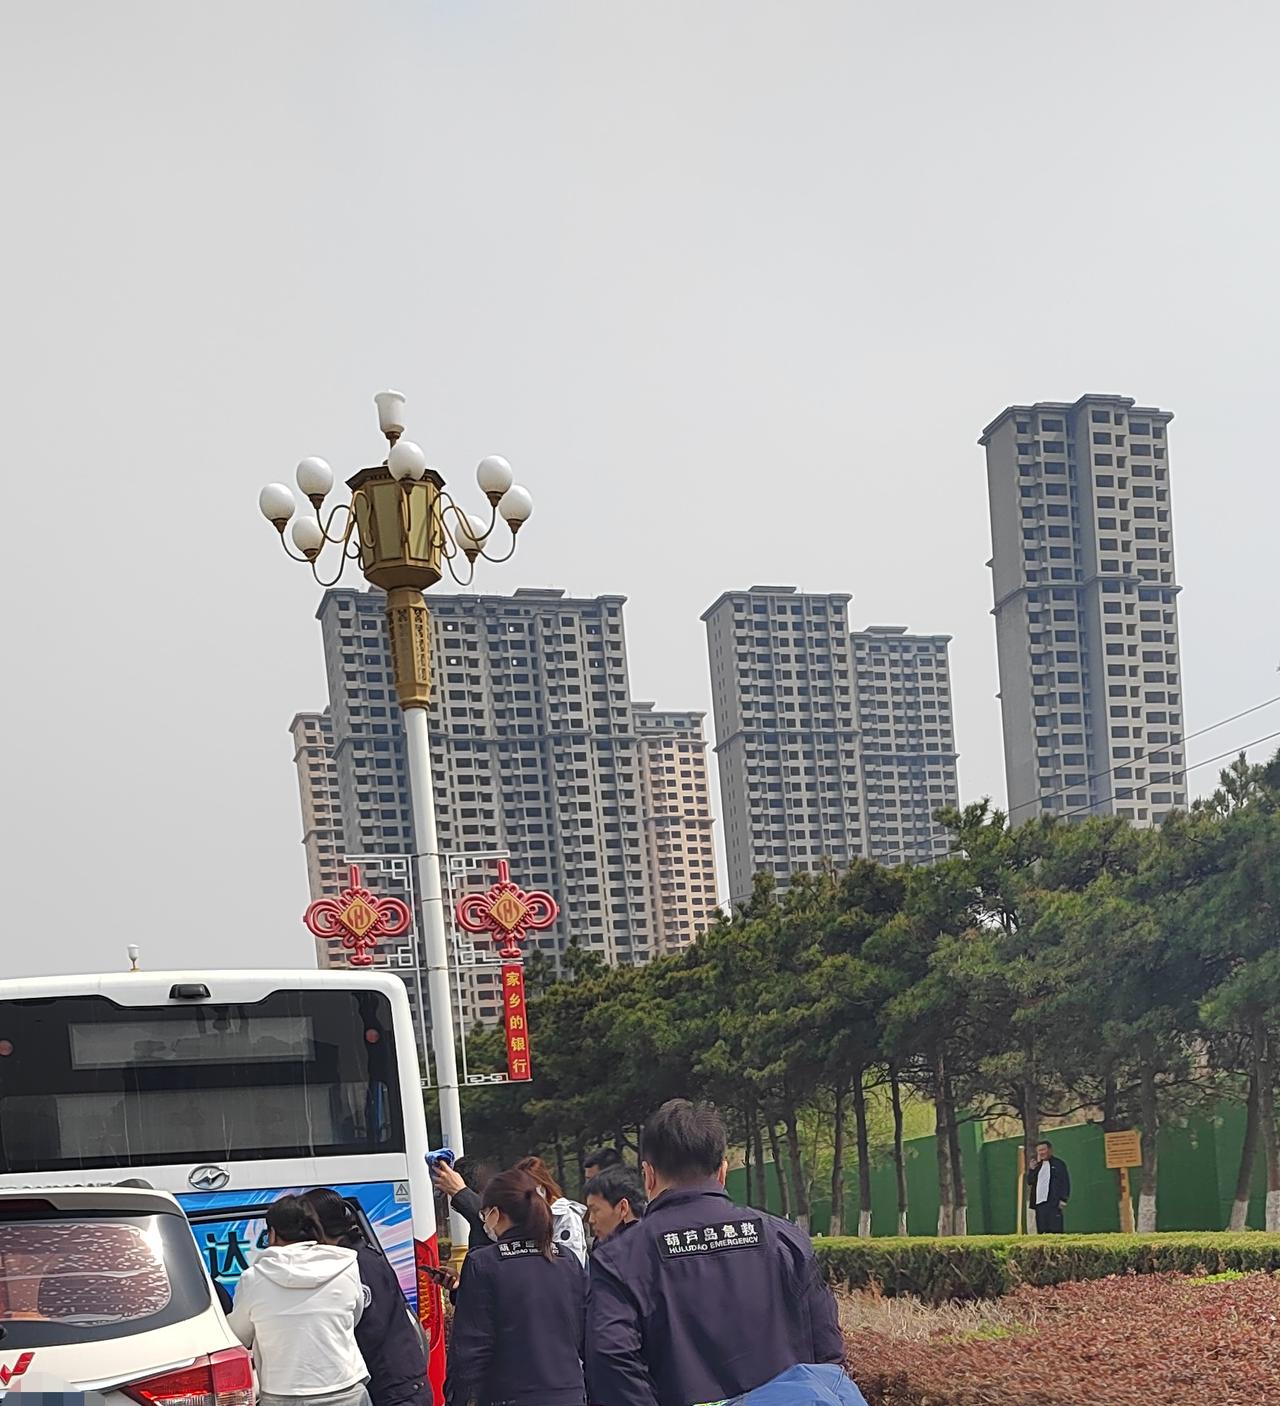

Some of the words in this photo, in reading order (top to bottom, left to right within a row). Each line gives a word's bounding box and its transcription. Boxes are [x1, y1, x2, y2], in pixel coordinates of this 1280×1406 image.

[506, 971, 527, 1073] 家乡的银行
[664, 1222, 757, 1246] 葫芦岛急救
[669, 1243, 708, 1254] HULUDAO
[710, 1236, 759, 1249] EMERGENCY
